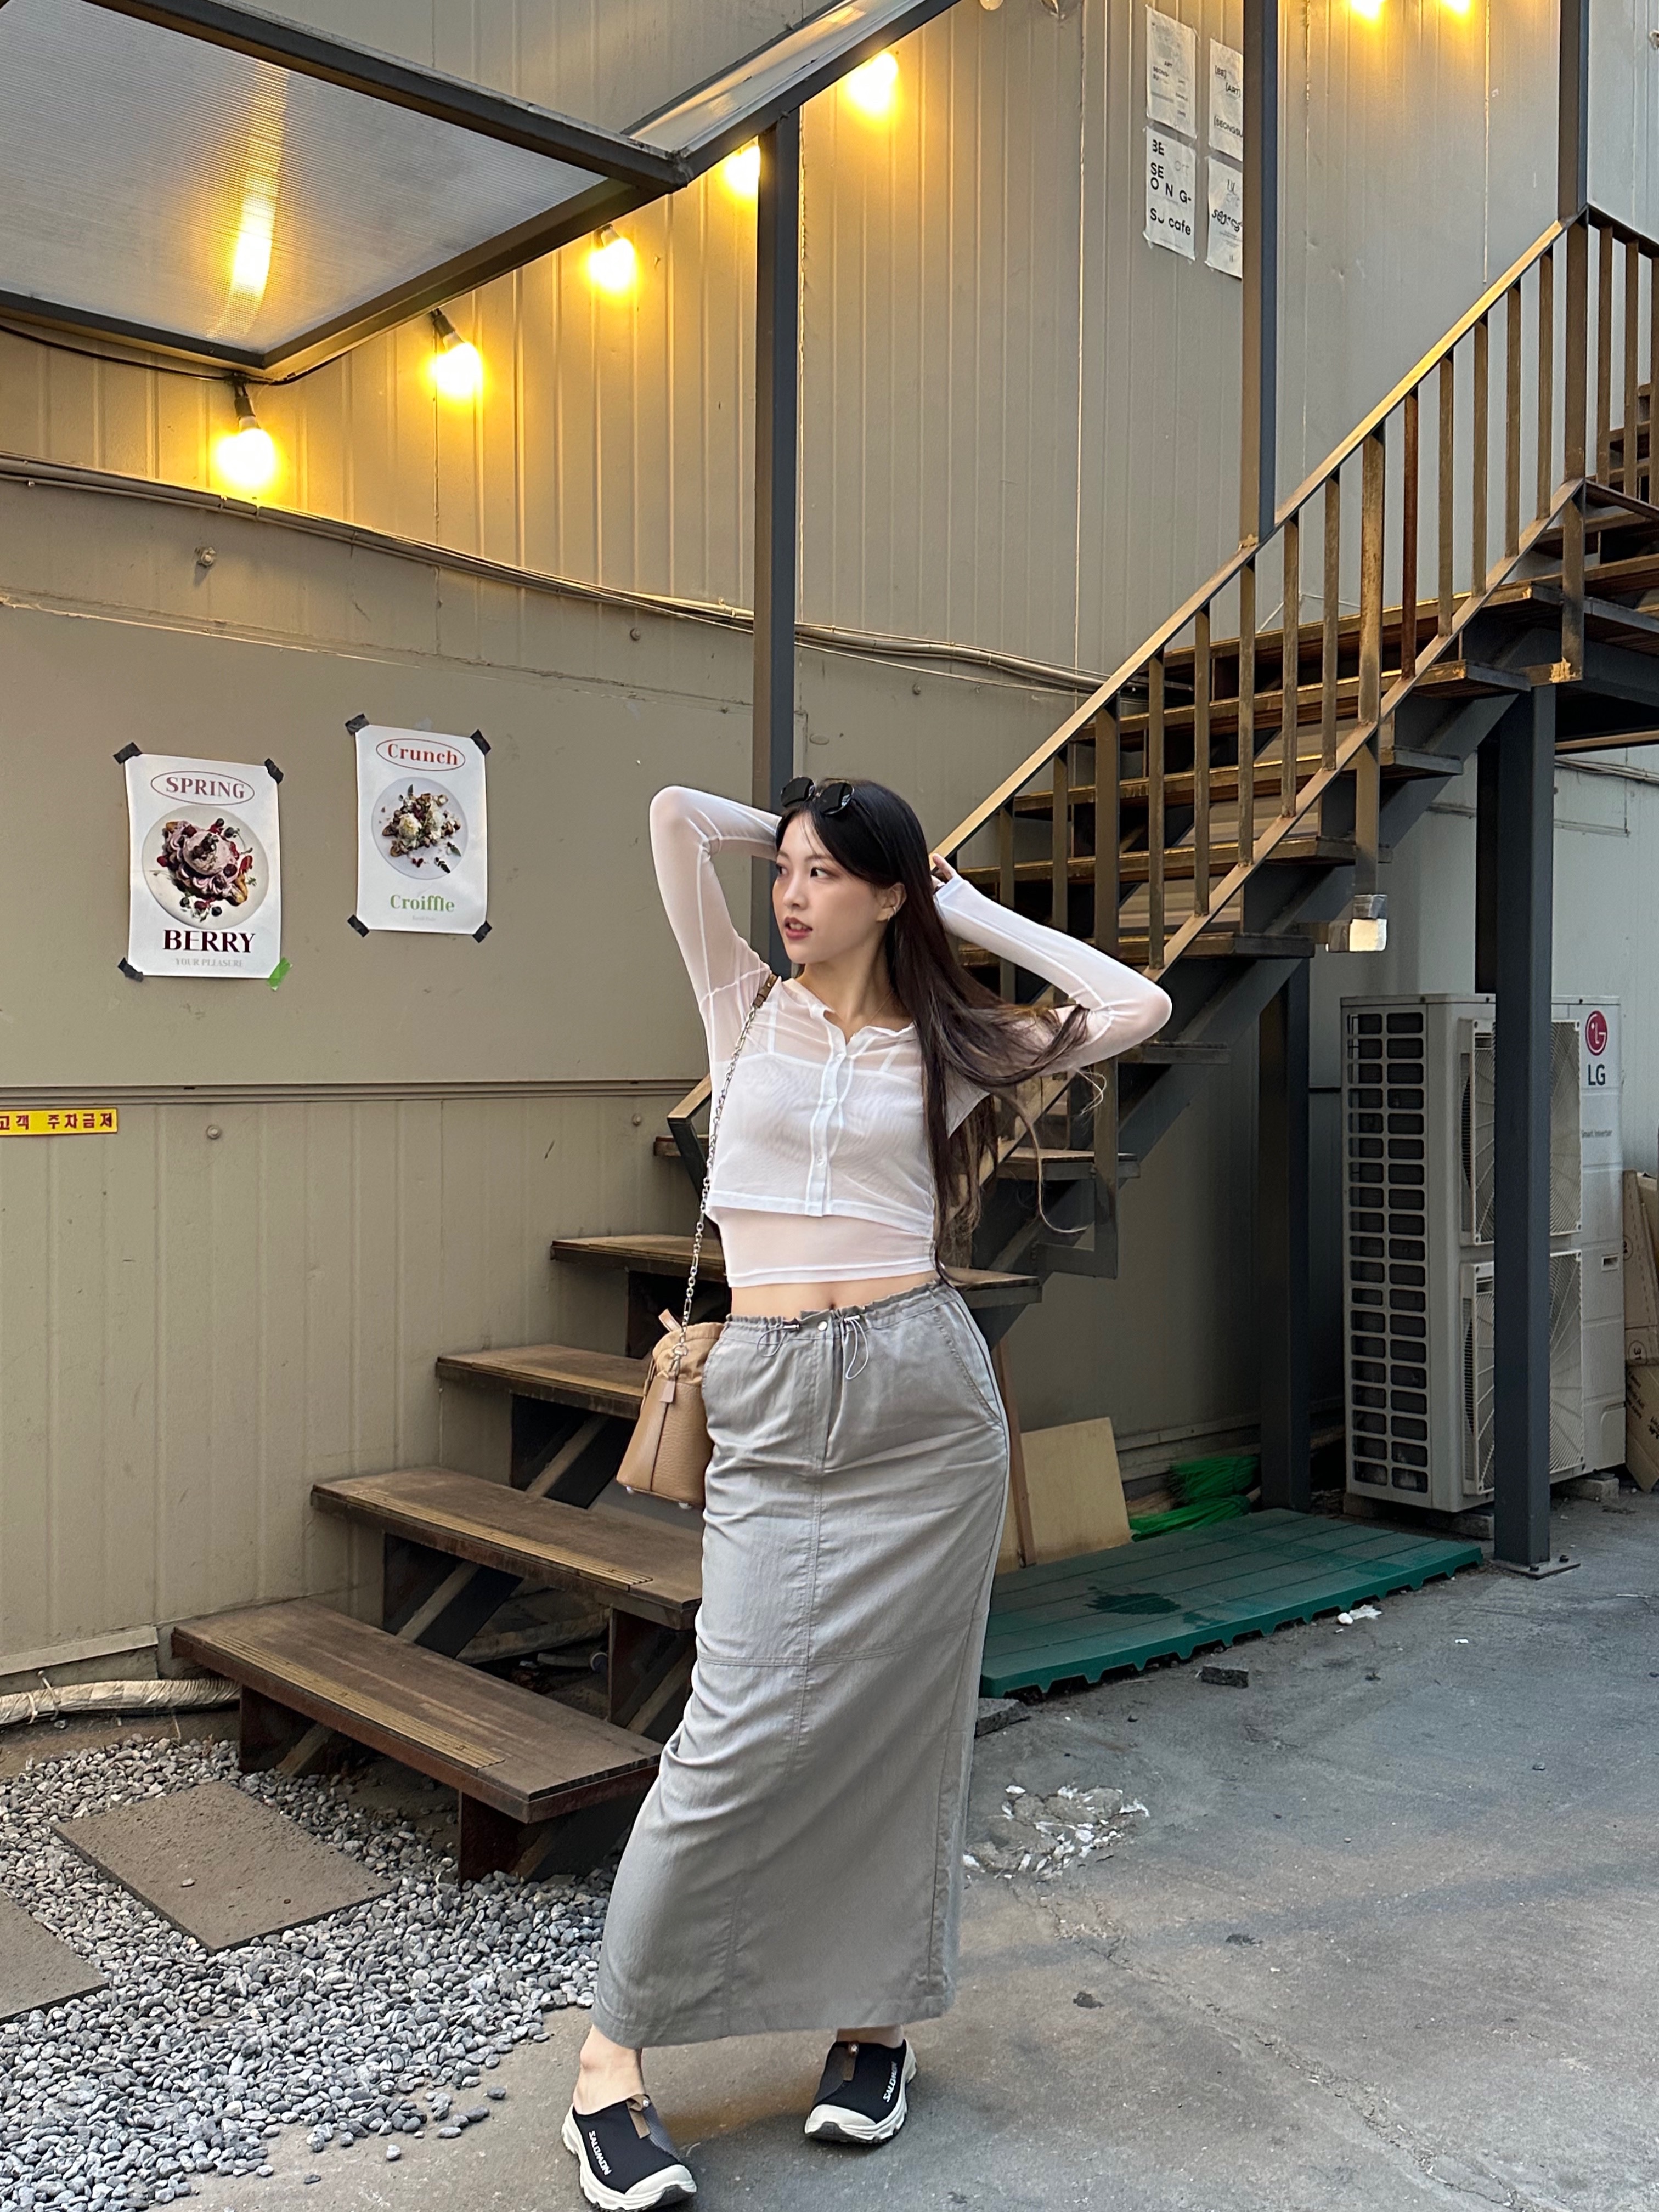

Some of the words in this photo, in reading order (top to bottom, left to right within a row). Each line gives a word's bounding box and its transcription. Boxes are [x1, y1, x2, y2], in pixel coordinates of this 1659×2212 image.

[1153, 139, 1165, 156] BE
[1150, 162, 1164, 179] SE
[1169, 218, 1191, 235] cafe
[387, 743, 458, 765] Crunch
[166, 776, 245, 799] SPRING
[390, 894, 455, 912] Croiffle
[163, 929, 256, 953] BERRY
[176, 958, 200, 966] YOUR
[201, 959, 242, 967] PLEASURE
[1588, 1063, 1606, 1086] LG
[0, 1115, 29, 1130] 고객
[588, 2130, 612, 2176] SALOMON
